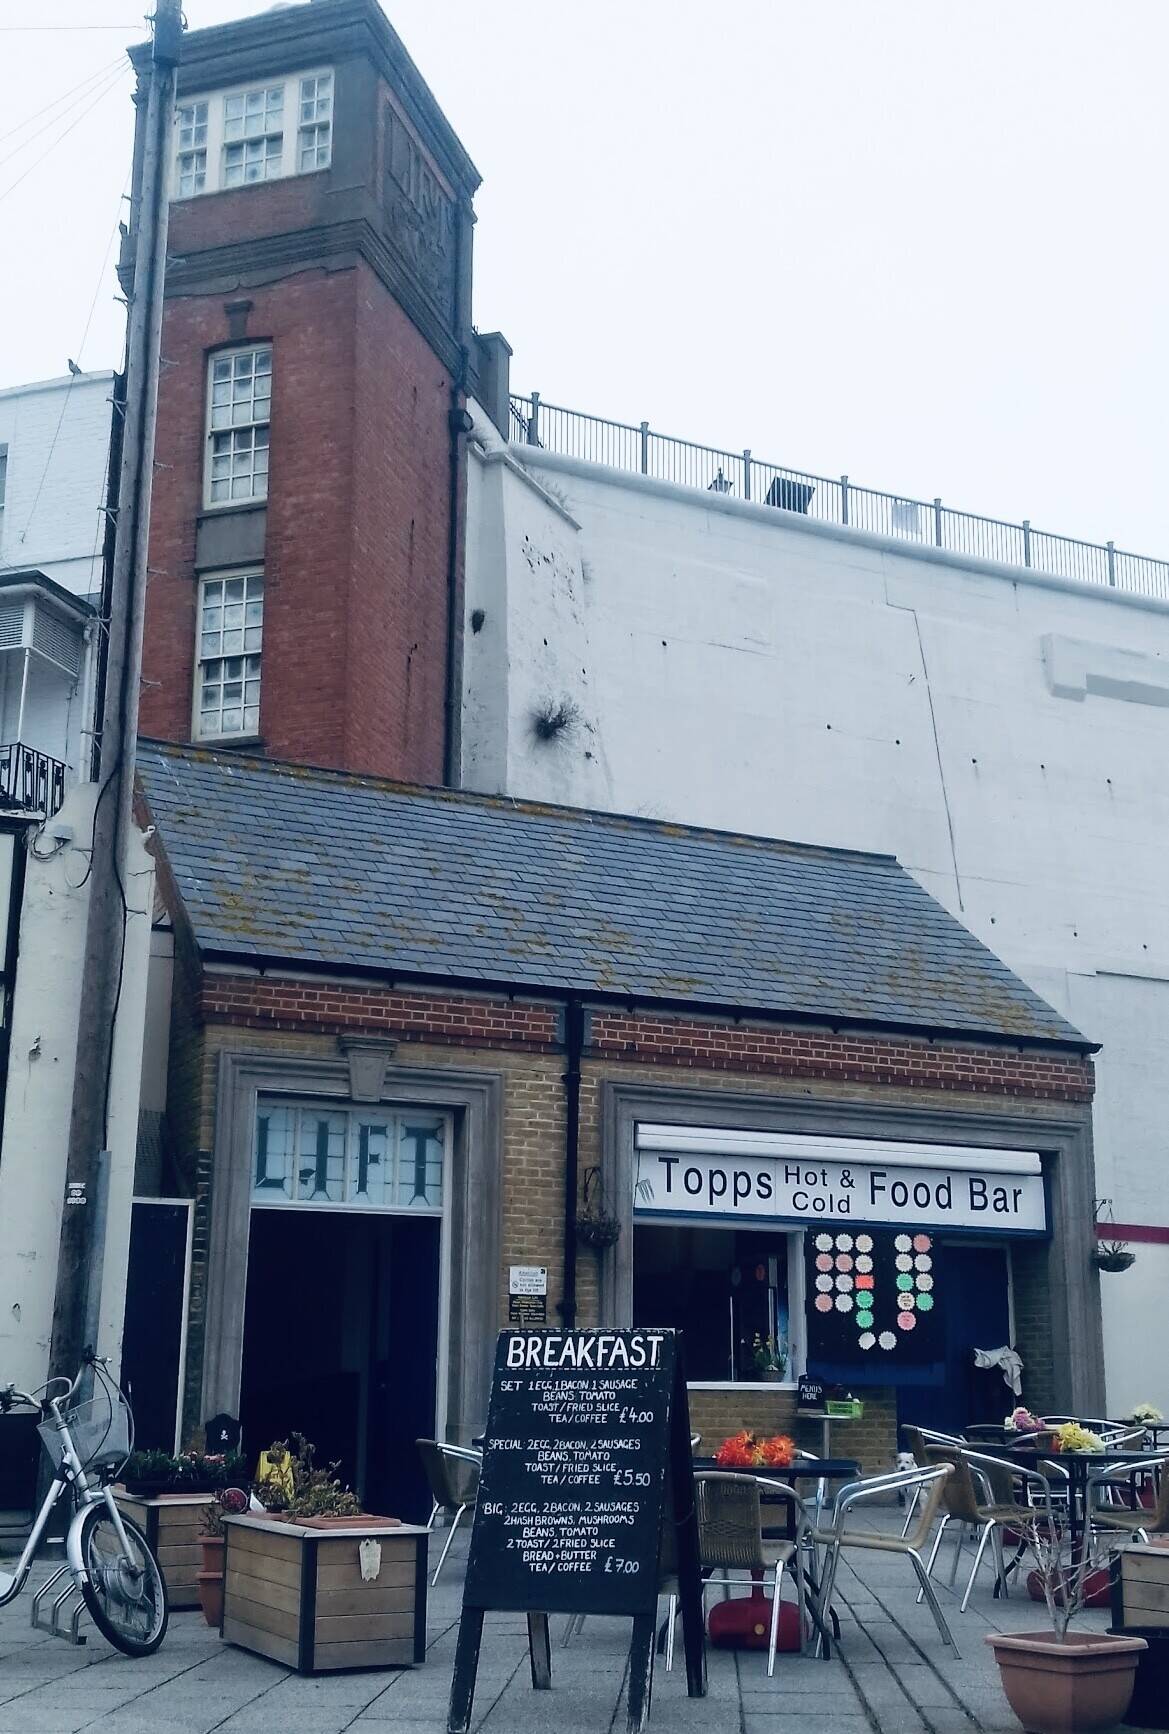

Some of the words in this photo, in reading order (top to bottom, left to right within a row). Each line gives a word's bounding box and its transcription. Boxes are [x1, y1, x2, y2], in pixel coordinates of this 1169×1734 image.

[256, 1116, 441, 1197] LIFT
[658, 1157, 773, 1208] Topps
[784, 1165, 828, 1187] Hot
[840, 1169, 856, 1189] &
[869, 1171, 953, 1209] Food
[969, 1177, 1023, 1214] Bar
[792, 1191, 851, 1214] Cold
[506, 1336, 665, 1368] BREAKFAST
[500, 1380, 524, 1392] SET
[579, 1390, 616, 1401] TOMATO
[596, 1402, 620, 1412] SLICE
[619, 1406, 654, 1424] £4.00
[573, 1450, 611, 1461] TOMATO
[592, 1462, 617, 1472] SLICE
[613, 1468, 651, 1487] £5.50
[578, 1514, 635, 1525] MUSHROOMS
[559, 1526, 599, 1536] TOMATO
[590, 1538, 616, 1549] SLICE
